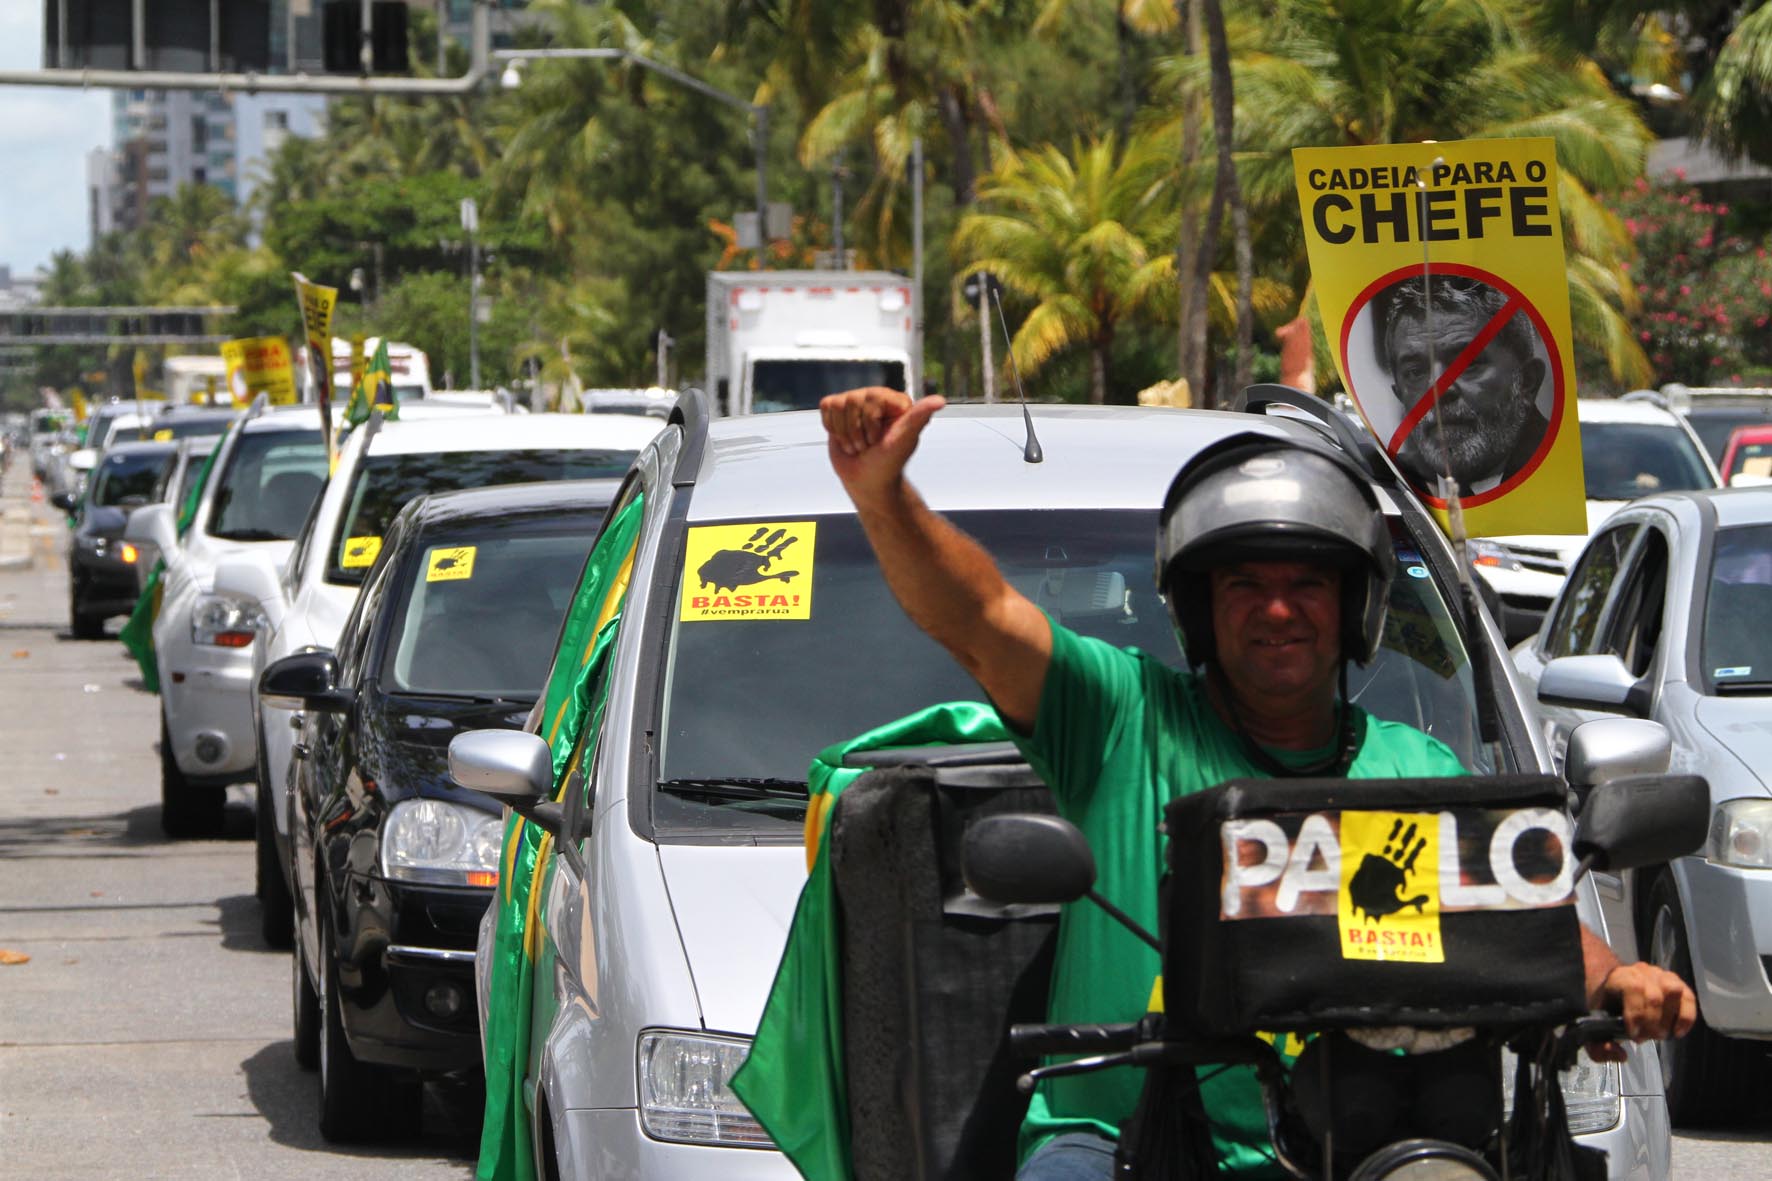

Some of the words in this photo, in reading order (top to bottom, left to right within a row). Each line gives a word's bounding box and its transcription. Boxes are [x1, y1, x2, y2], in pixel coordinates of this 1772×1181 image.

[1308, 165, 1420, 190] CADEIA
[1433, 161, 1516, 187] PARA
[1525, 160, 1547, 183] O
[1312, 186, 1553, 245] CHEFE
[691, 594, 800, 609] BASTA!
[701, 608, 790, 616] #vemprarua
[1220, 807, 1575, 917] PALO
[1348, 928, 1433, 948] BASTA!
